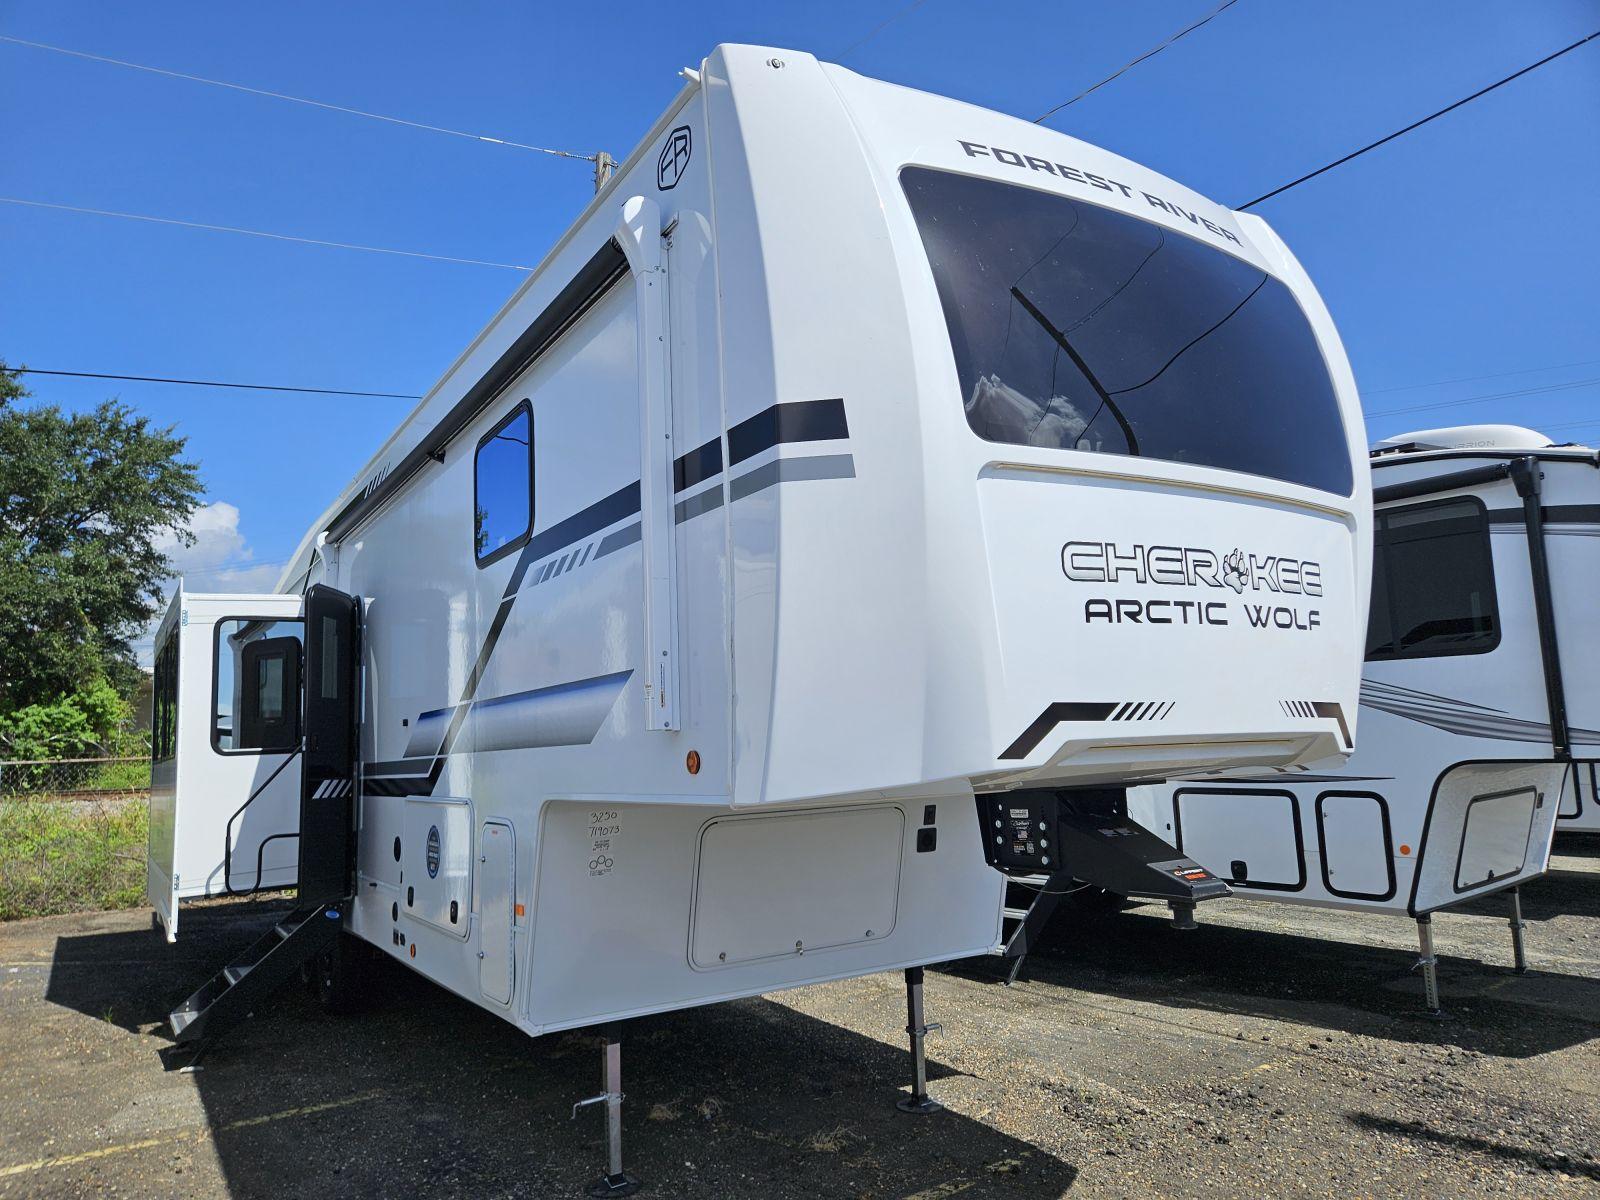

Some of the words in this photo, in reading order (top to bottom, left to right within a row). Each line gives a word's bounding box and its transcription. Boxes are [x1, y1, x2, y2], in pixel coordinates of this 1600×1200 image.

[957, 139, 1133, 199] FOREST
[1142, 191, 1244, 248] RIVER
[1084, 598, 1229, 625] ARCTIC
[1243, 603, 1321, 631] WOLF
